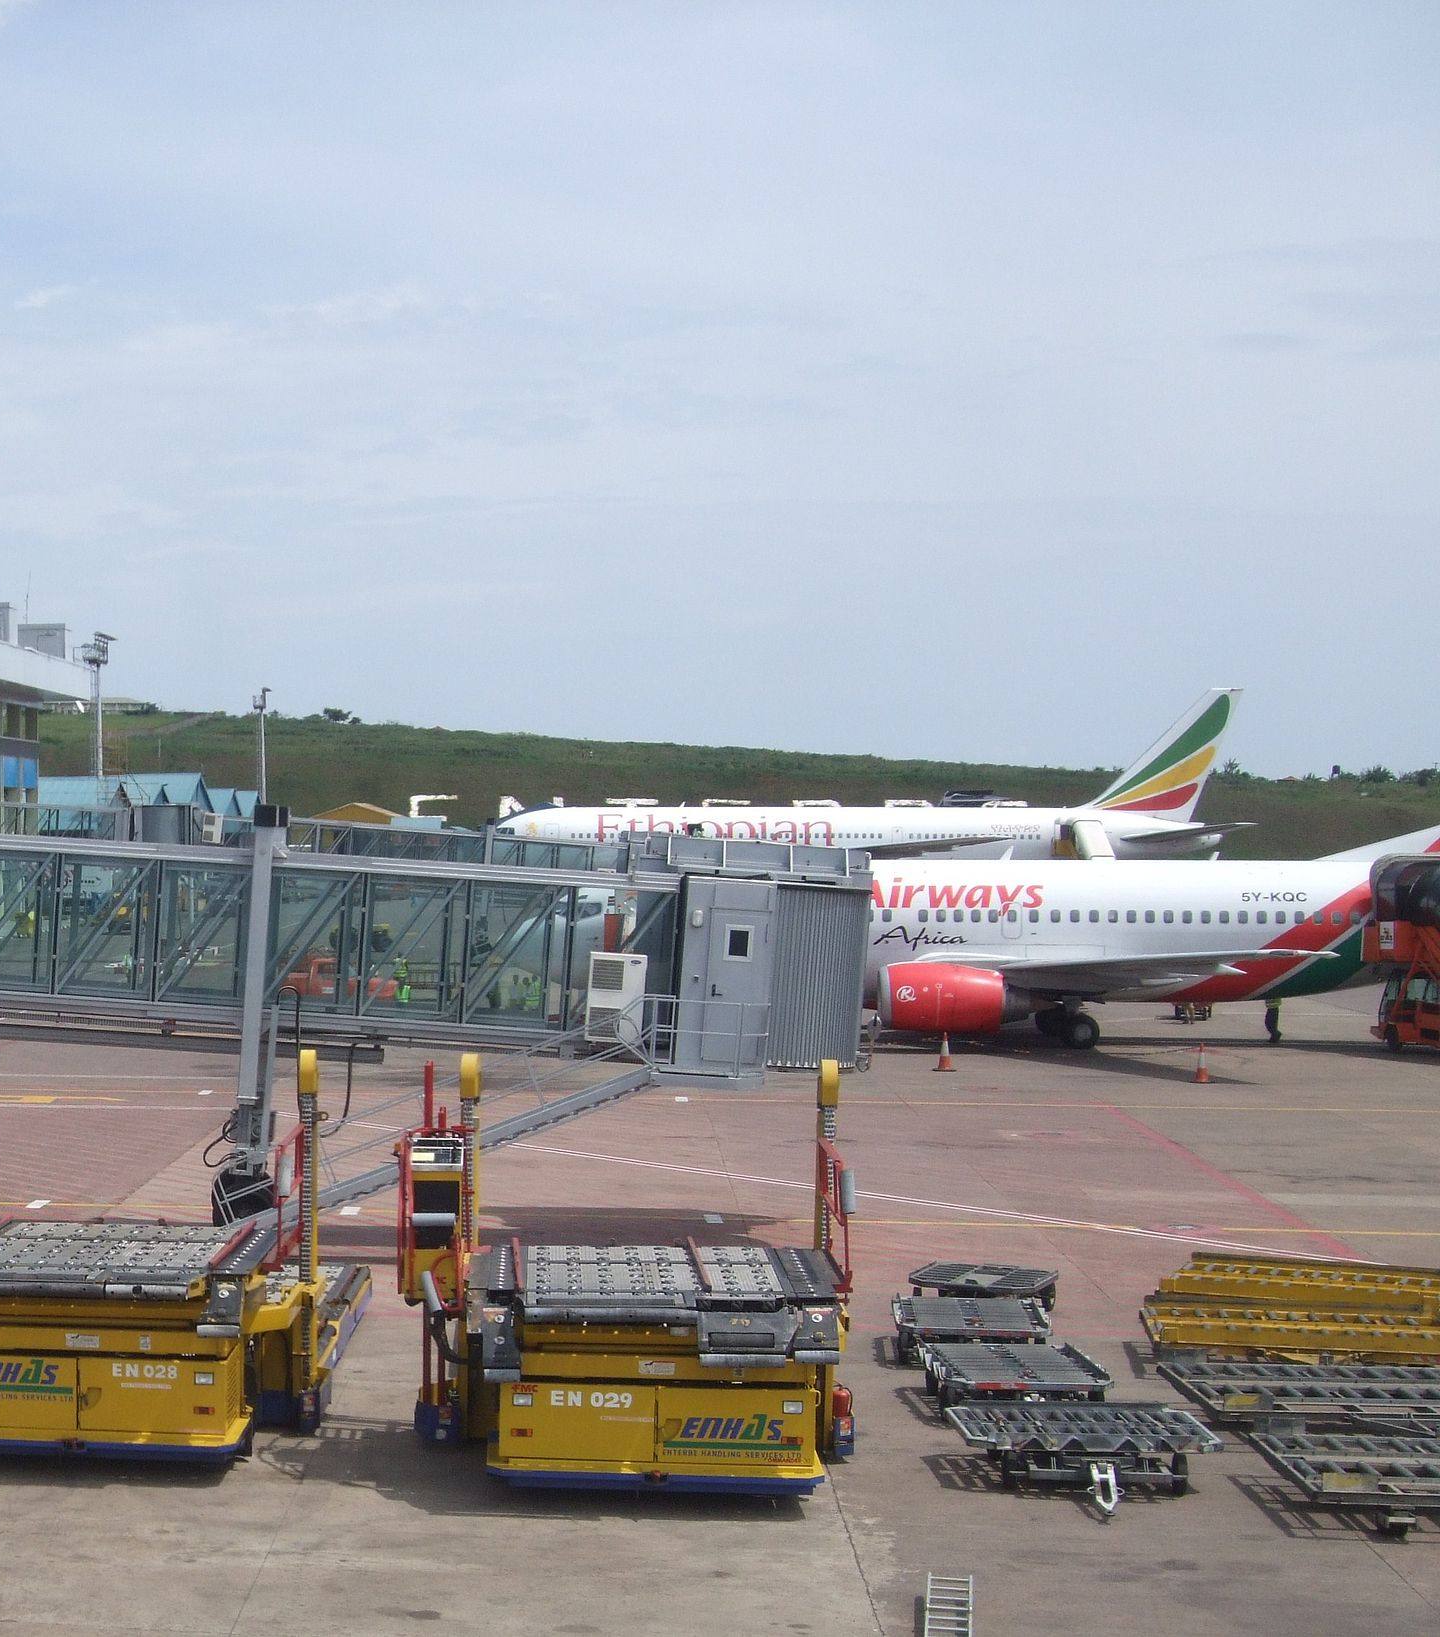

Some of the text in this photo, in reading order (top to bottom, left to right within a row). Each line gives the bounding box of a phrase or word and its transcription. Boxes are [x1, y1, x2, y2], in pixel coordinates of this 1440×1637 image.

[871, 877, 1045, 917] Airways
[1242, 892, 1308, 903] 5Y-KQC
[873, 925, 969, 952] Africa
[112, 1363, 178, 1380] EN 028
[550, 1390, 633, 1409] EN 029
[701, 1449, 741, 1458] HANDLING
[746, 1451, 784, 1459] SERVICES
